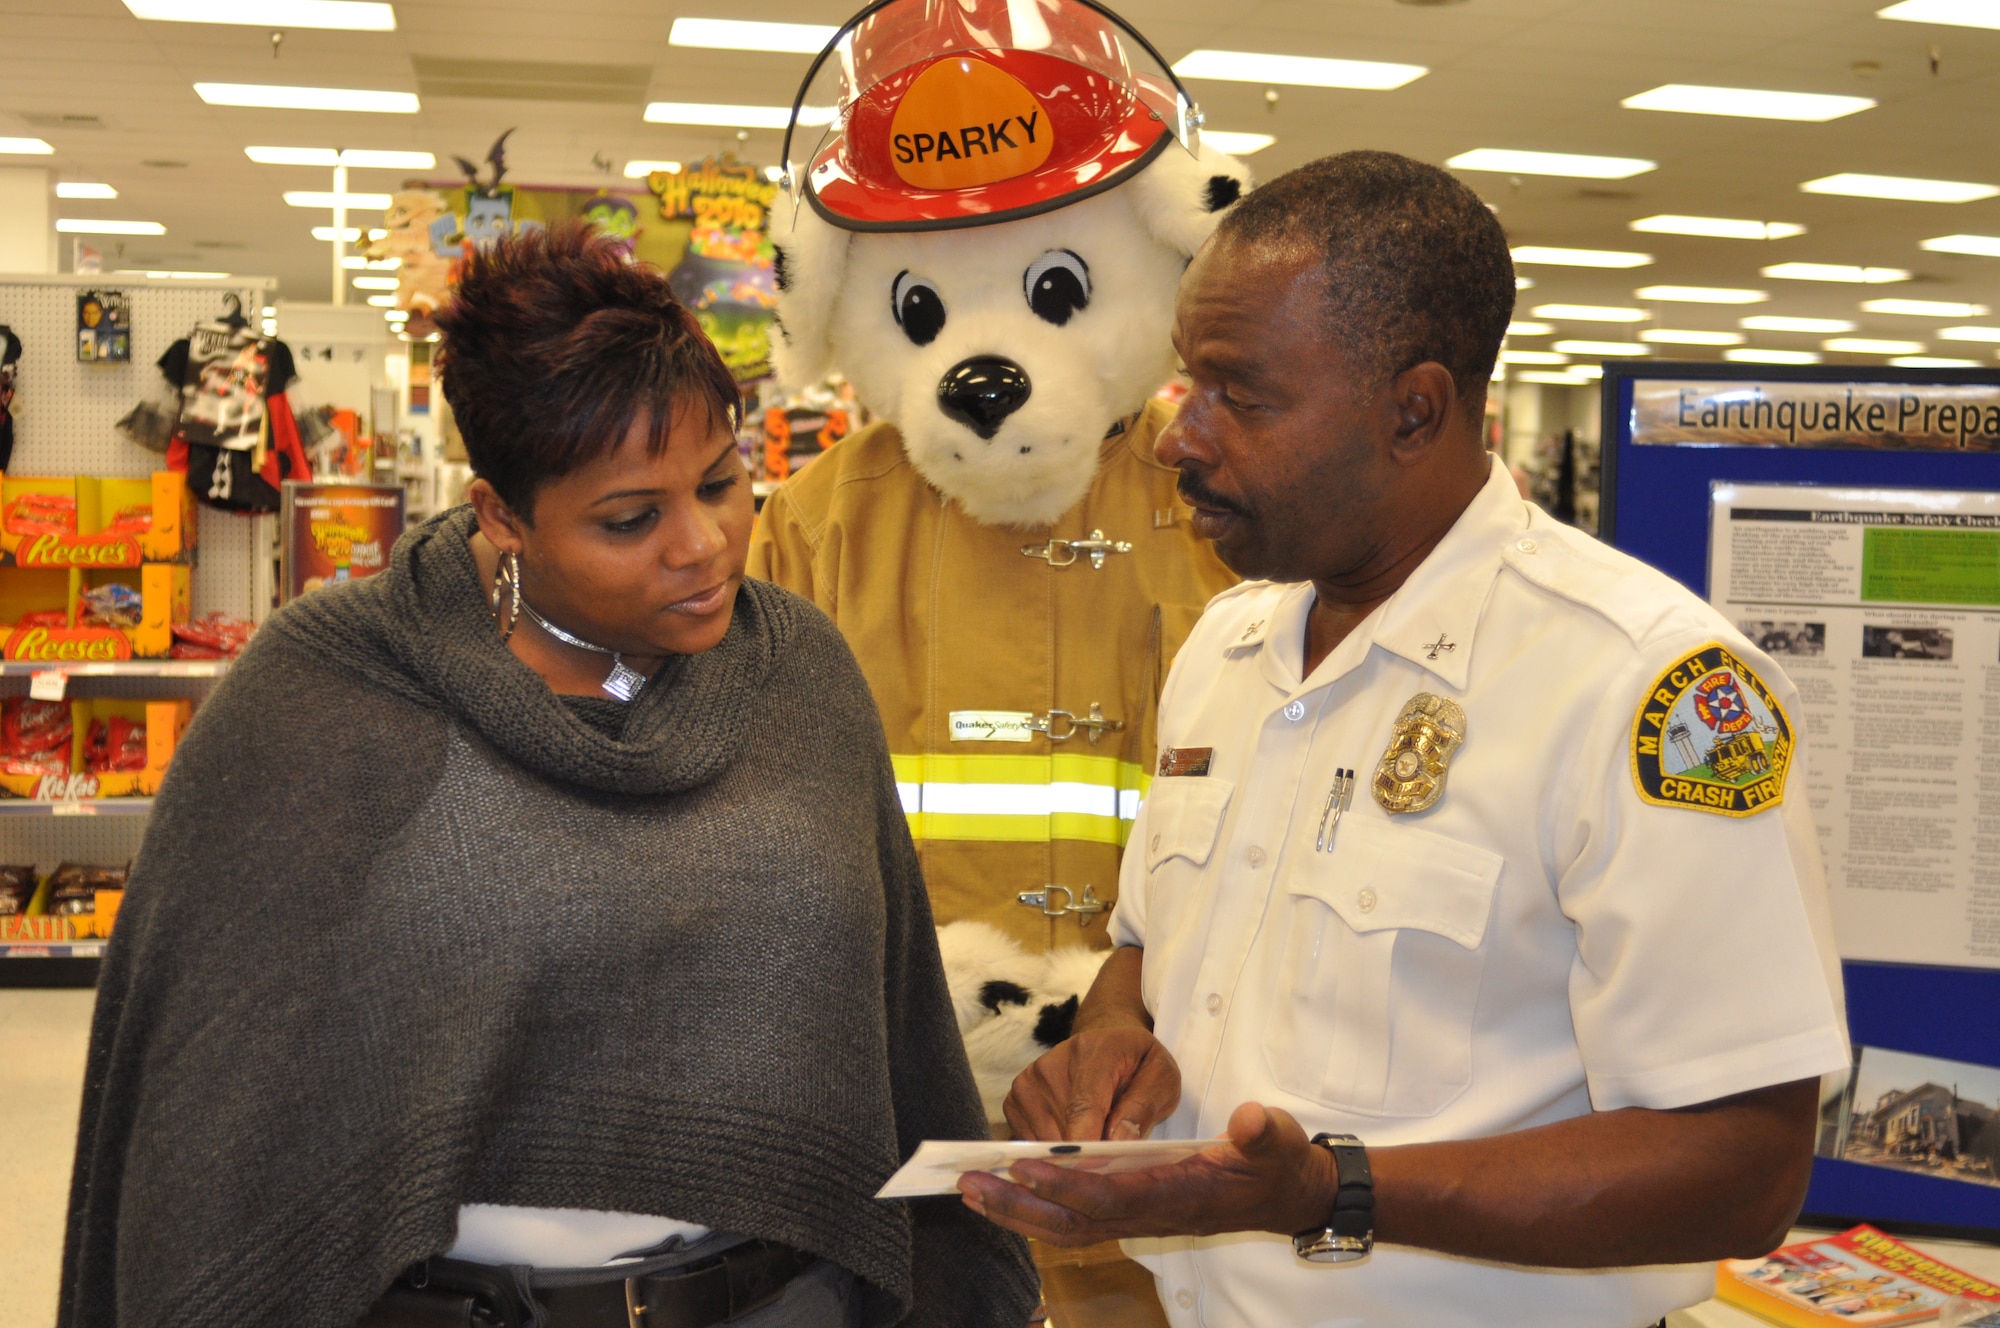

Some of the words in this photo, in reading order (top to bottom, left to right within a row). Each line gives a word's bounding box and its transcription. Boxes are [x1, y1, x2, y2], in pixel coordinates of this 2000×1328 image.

[893, 111, 1038, 164] SPARKY
[692, 196, 763, 230] 2010
[1678, 387, 1887, 442] Earthquake
[1812, 511, 1902, 525] Earthquake
[1904, 513, 1954, 528] Safety
[26, 534, 128, 564] Reese's
[14, 627, 116, 661] Reese's
[1702, 676, 1727, 693] FIRE
[1638, 657, 1707, 756] MARCH
[1660, 778, 1735, 808] CRASH
[1742, 780, 1778, 808] FIR
[1852, 1230, 2000, 1297] FIREFIGHTERS
